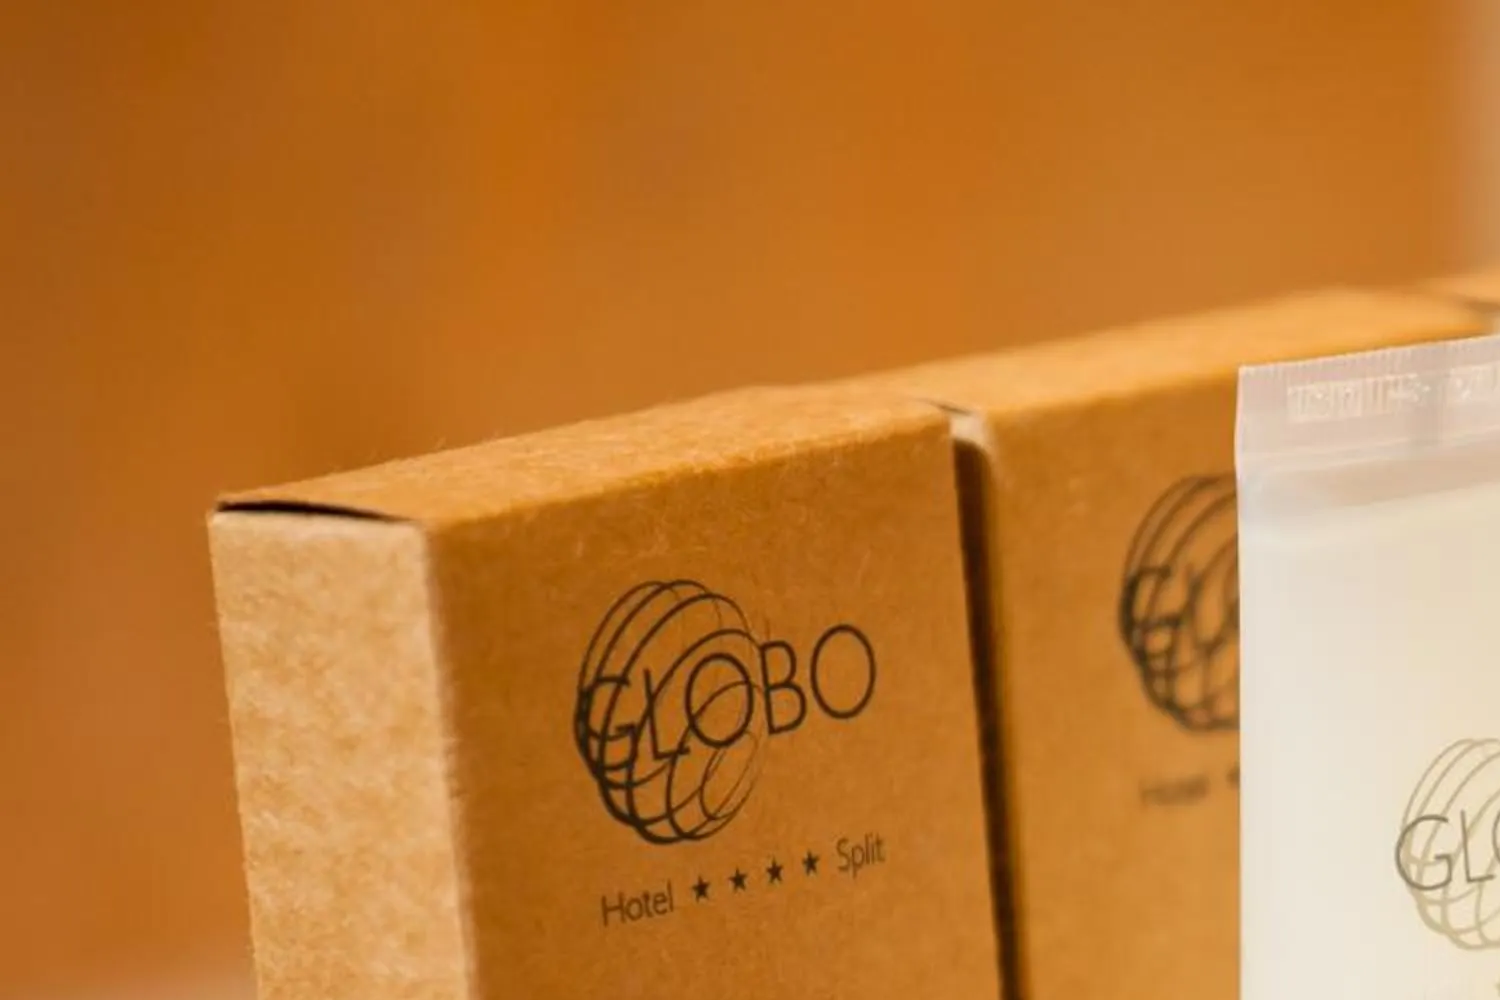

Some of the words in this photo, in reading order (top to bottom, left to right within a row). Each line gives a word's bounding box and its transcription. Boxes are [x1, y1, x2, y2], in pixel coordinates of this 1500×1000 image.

[577, 624, 876, 769] GLOBO
[601, 881, 674, 926] Hotel
[837, 833, 885, 878] Split
